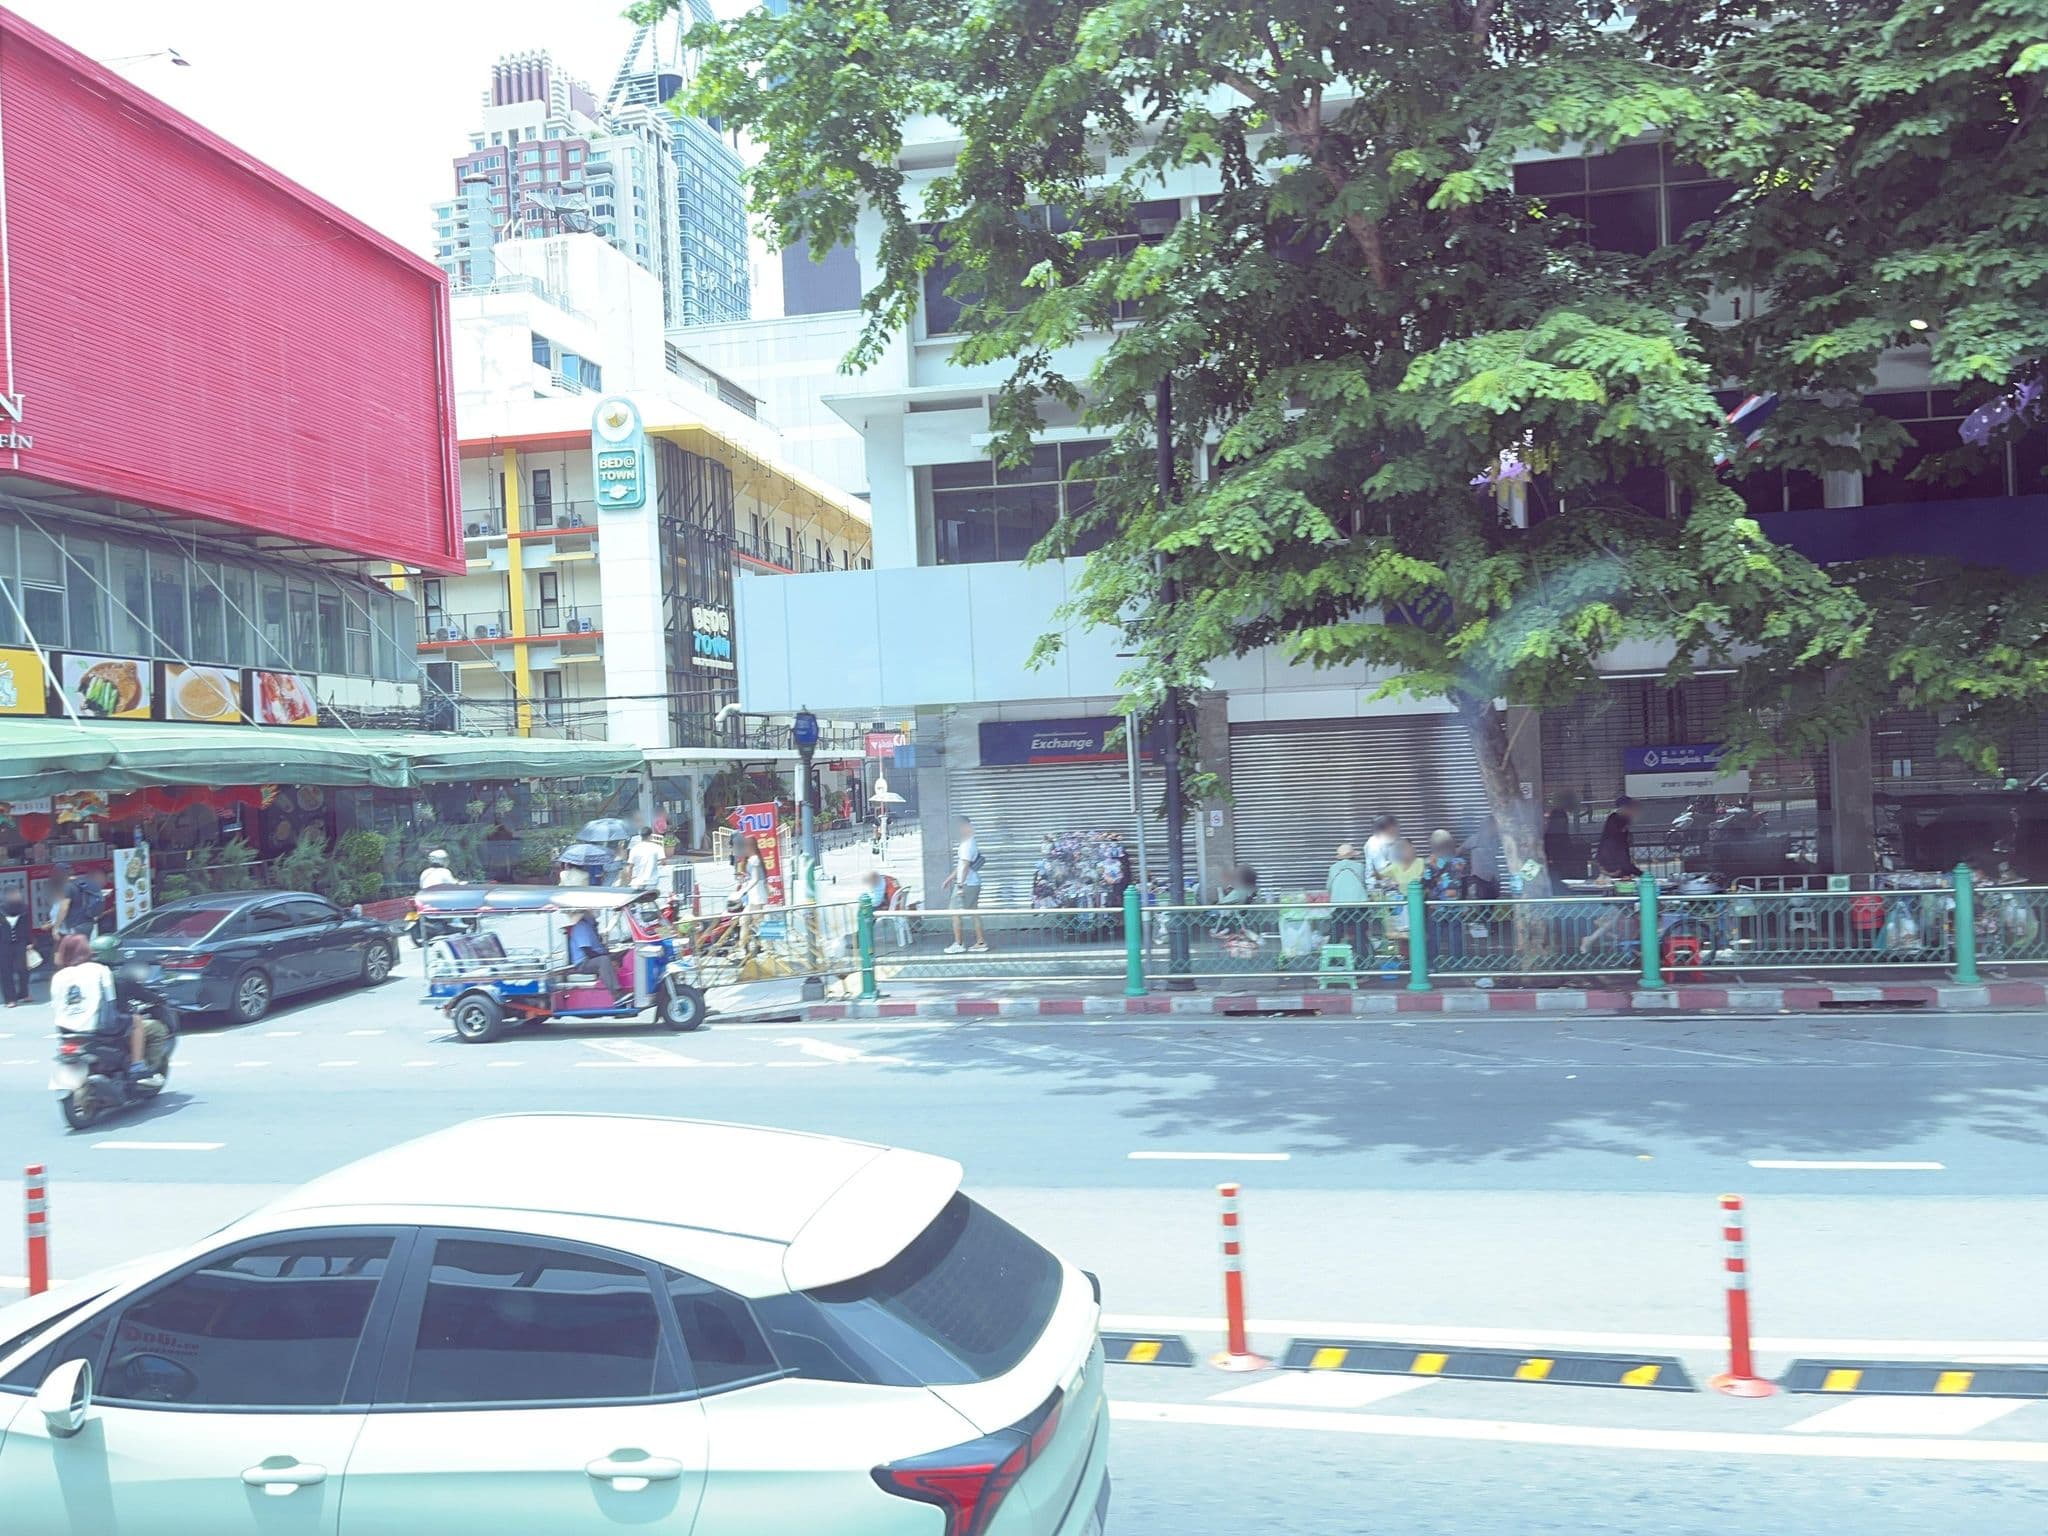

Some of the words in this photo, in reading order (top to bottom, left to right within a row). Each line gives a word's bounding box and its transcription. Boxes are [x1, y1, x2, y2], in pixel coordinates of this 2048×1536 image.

[600, 456, 635, 469] BED@
[600, 470, 636, 481] TOWN
[693, 630, 731, 660] TOWN
[1031, 738, 1093, 750] Exchange
